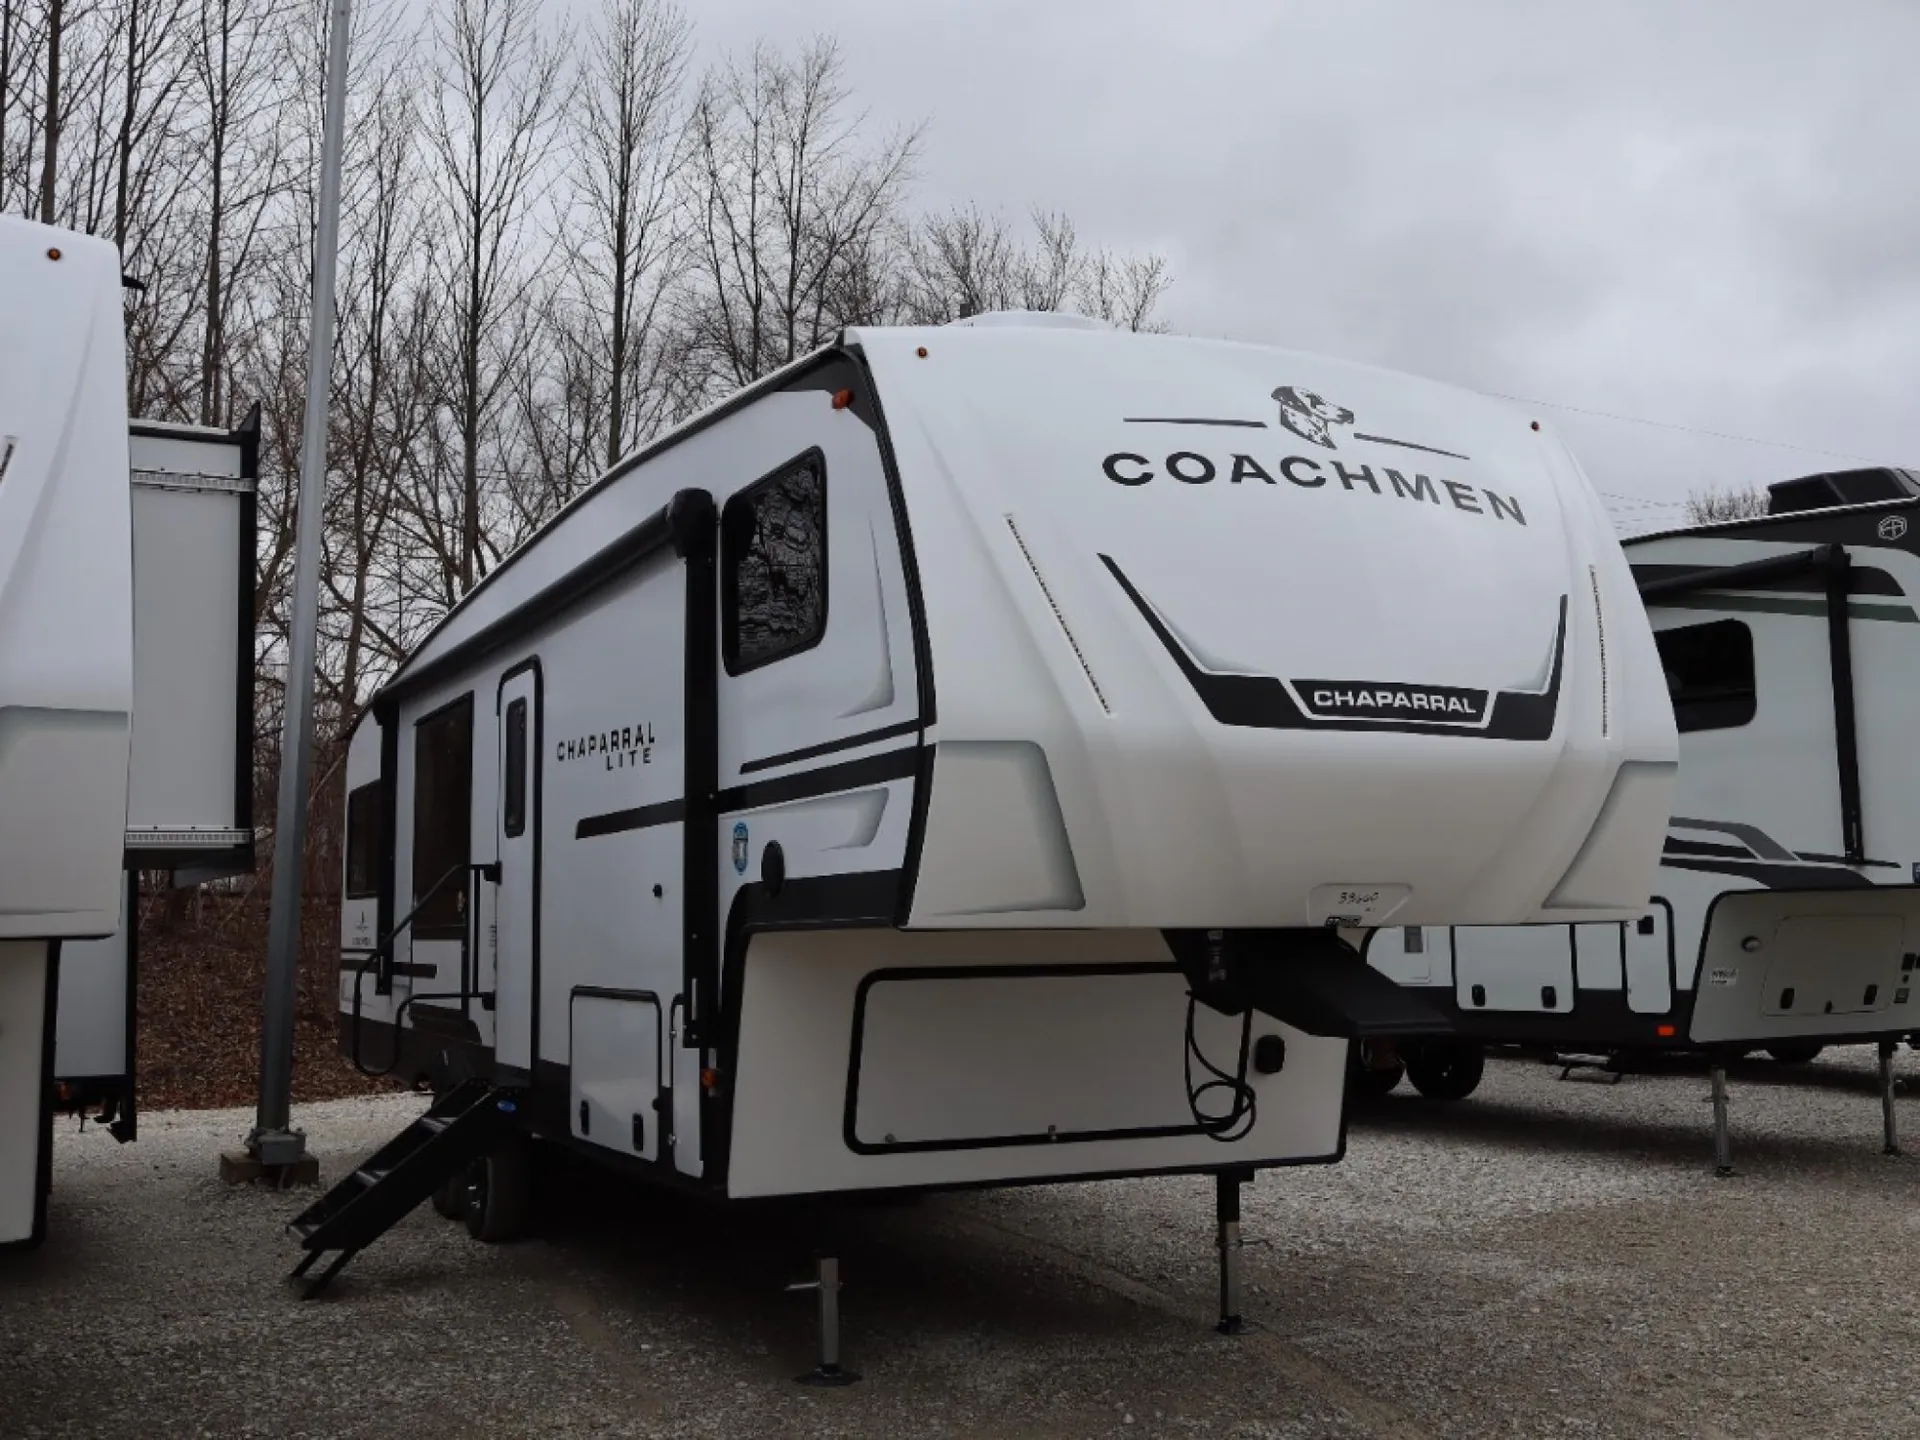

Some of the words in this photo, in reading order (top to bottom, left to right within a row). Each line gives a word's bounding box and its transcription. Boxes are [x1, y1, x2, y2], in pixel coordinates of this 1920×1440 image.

[1102, 452, 1528, 526] COACHMEN
[1313, 689, 1477, 714] CHAPARRAL
[556, 722, 655, 762] CHAPARRAL
[606, 747, 652, 771] LITE
